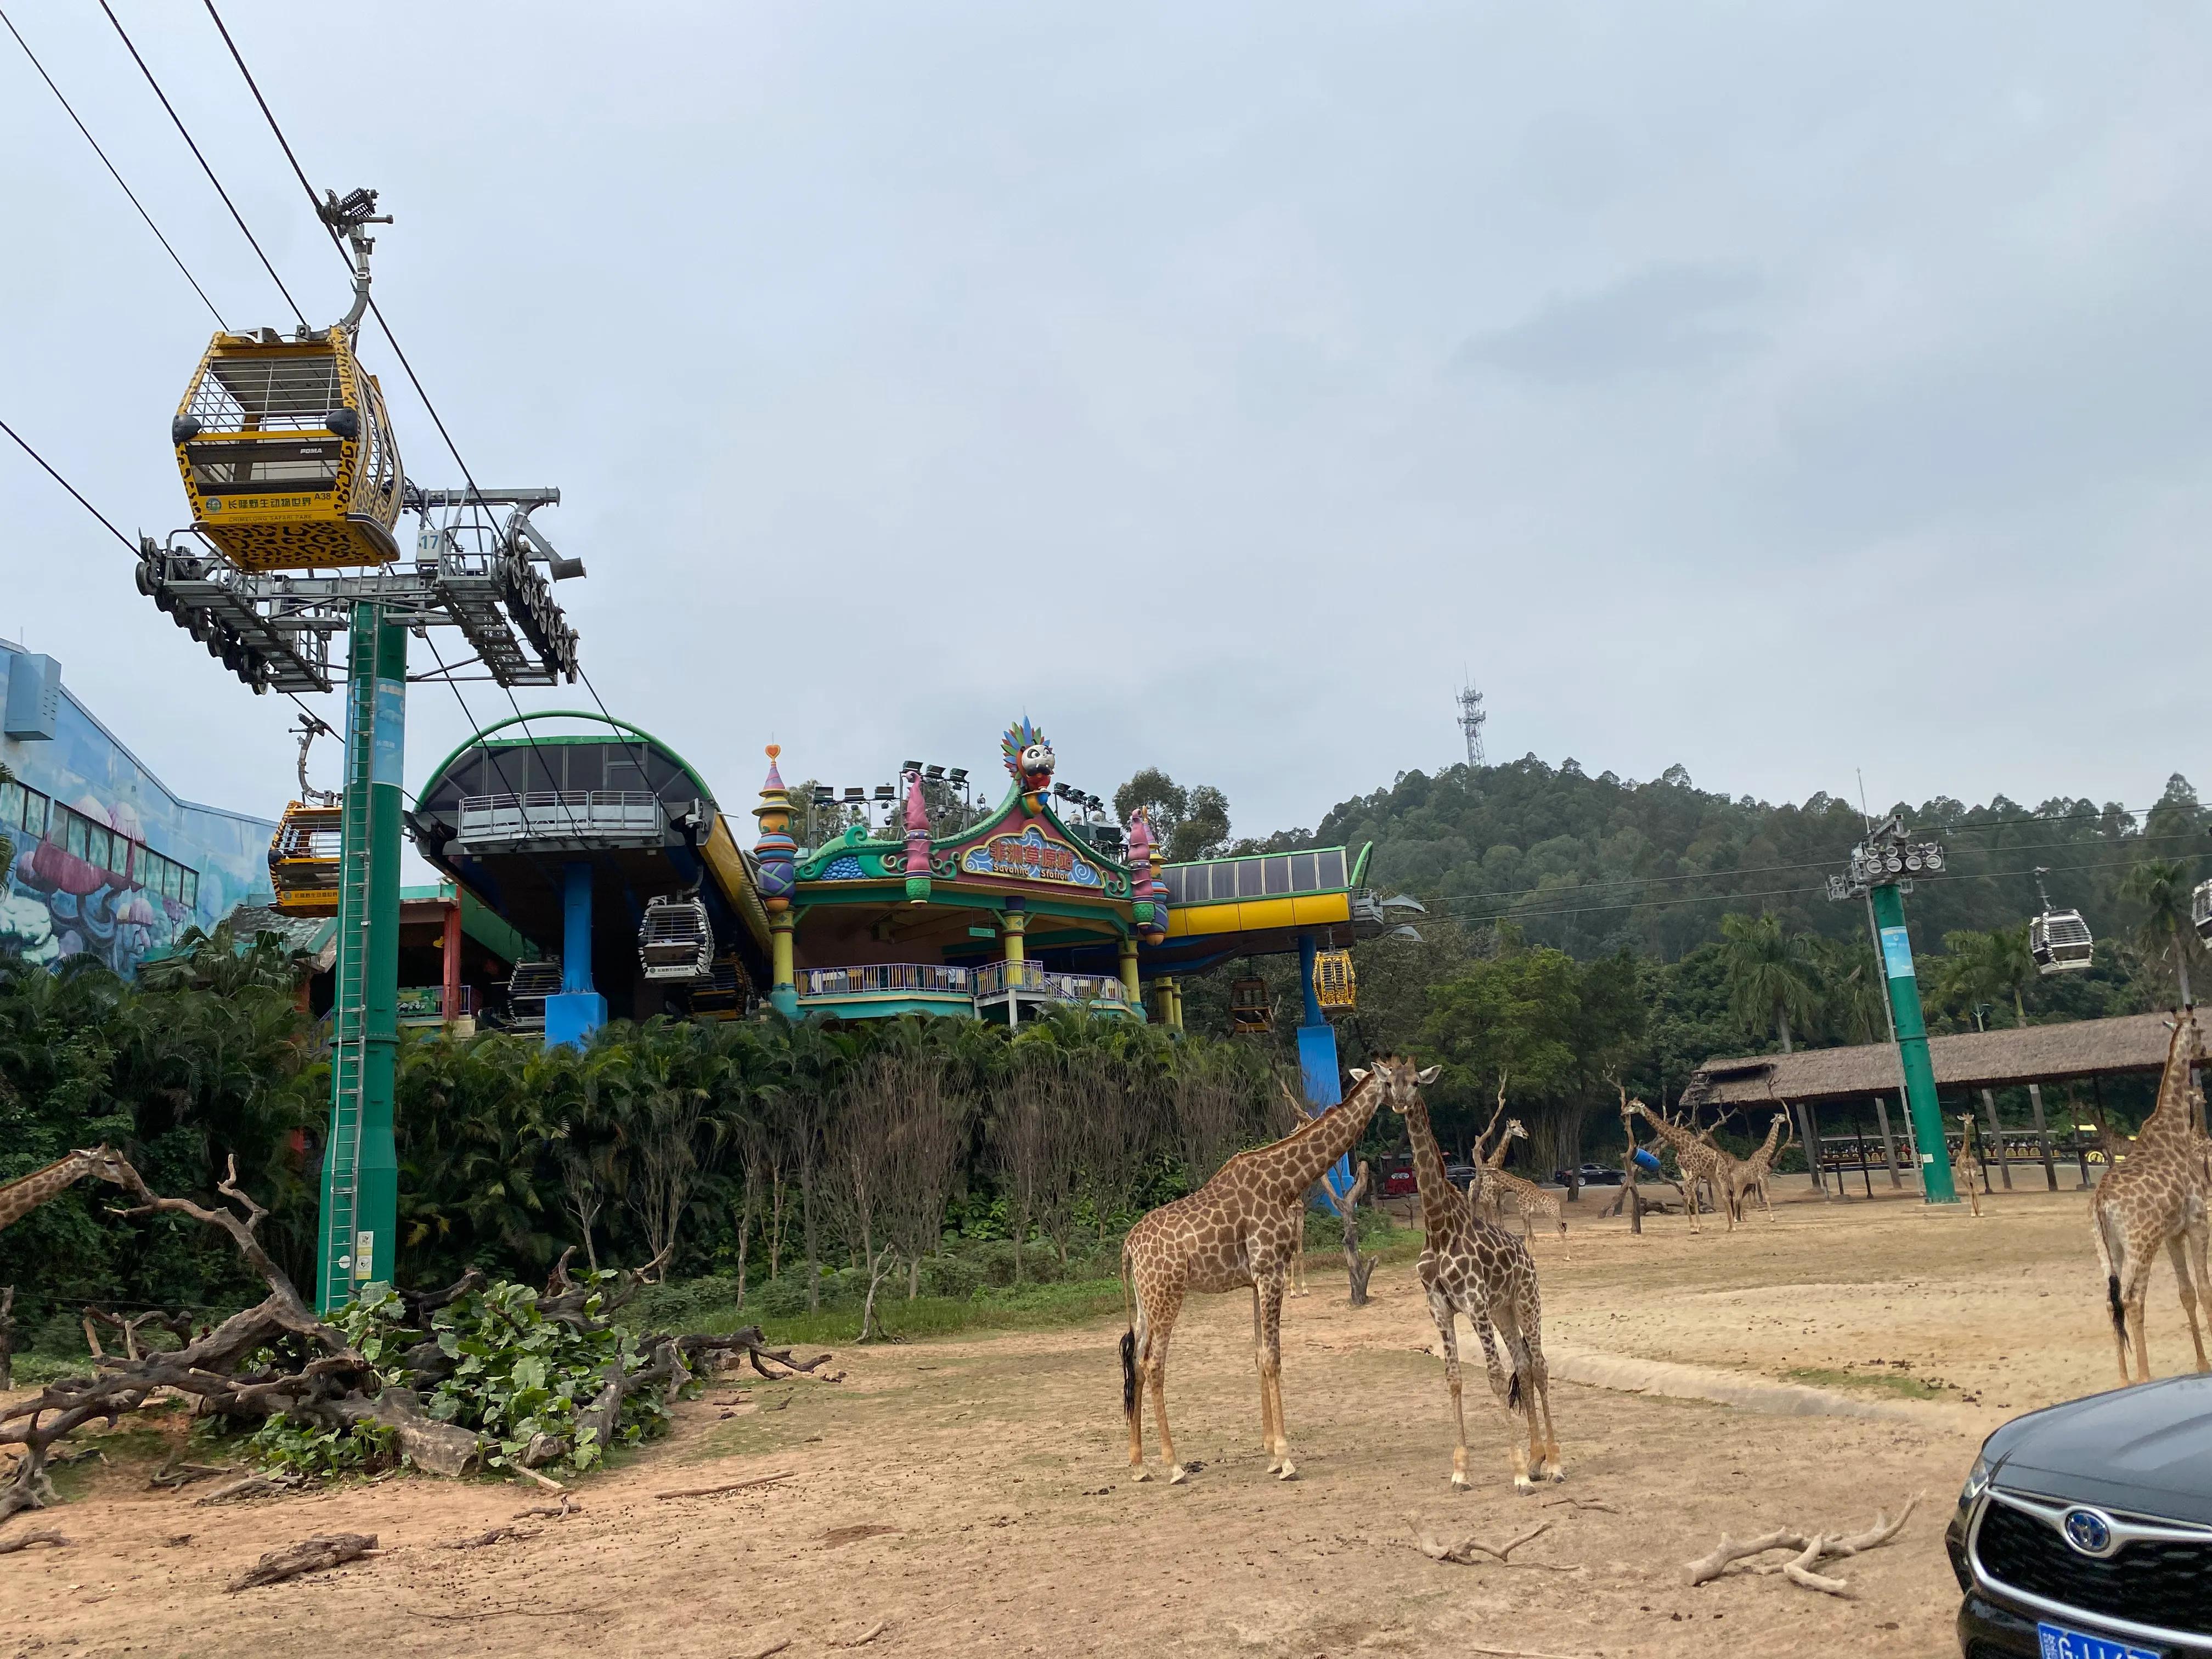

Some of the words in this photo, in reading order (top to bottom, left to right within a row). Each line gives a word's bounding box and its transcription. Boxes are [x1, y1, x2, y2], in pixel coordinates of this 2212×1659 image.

[228, 497, 312, 510] 长隆野生动物世界
[421, 535, 439, 550] 17
[990, 841, 1074, 871] 非洲草原站
[1041, 869, 1070, 880] Station
